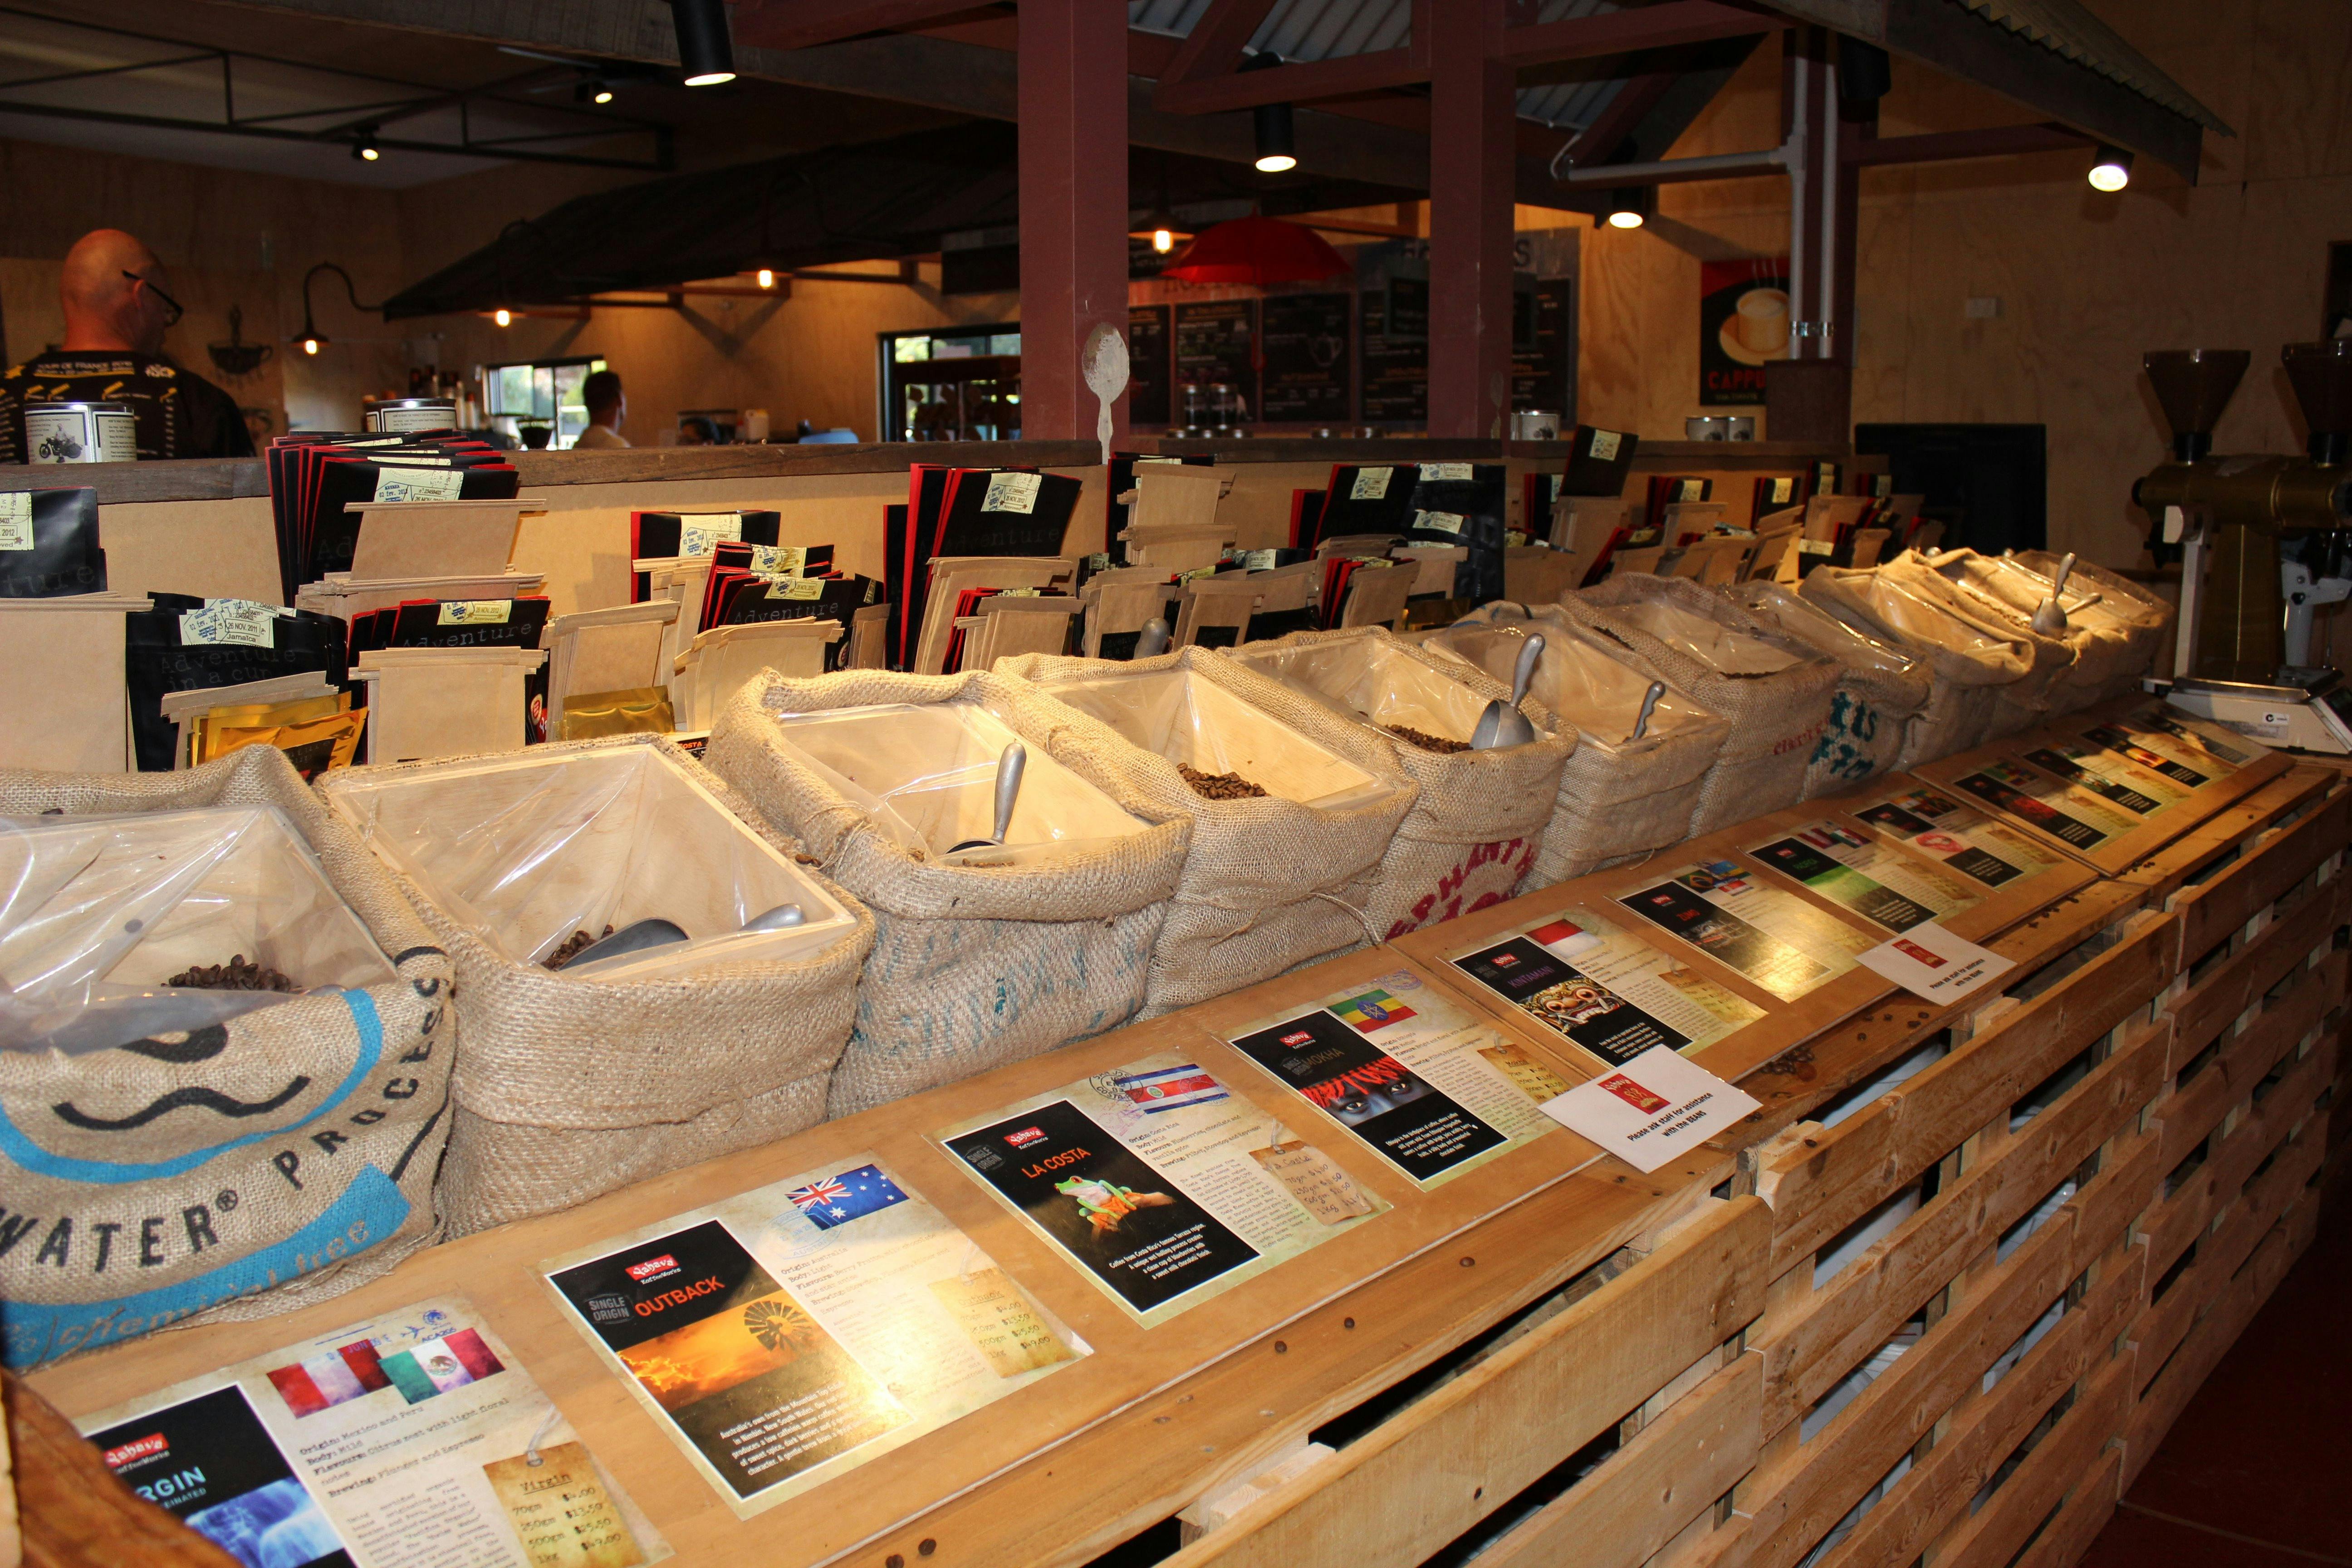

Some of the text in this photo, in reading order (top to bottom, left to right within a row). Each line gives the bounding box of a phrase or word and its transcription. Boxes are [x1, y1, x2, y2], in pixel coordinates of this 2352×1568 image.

[1708, 368, 1766, 390] CAPPU
[733, 603, 838, 625] Adventure
[403, 623, 531, 648] Adventure
[161, 647, 296, 675] Adventure
[209, 672, 223, 683] a
[1507, 965, 1555, 989] KINTAMANI
[1301, 1048, 1345, 1066] MOKHA
[1627, 1092, 1714, 1142] Please ask staff for assistance
[1661, 1110, 1707, 1137] with the BEANS
[1010, 1129, 1041, 1143] Yahava
[1128, 1133, 1151, 1143] Origin:
[1150, 1127, 1166, 1135] Costa
[1136, 1141, 1152, 1149] Body:
[1144, 1142, 1172, 1156] Flavours:
[1172, 1129, 1206, 1146] Blueberries,
[1205, 1119, 1230, 1132] chocolate
[966, 1147, 992, 1163] SINGLE
[1152, 1144, 1190, 1161] vanilla spice
[1159, 1126, 1261, 1169] Brewing: Filter, Stovetop Espresso
[976, 1154, 1002, 1170] ORIGIN
[1022, 1147, 1091, 1179] LA COSTA
[1285, 1175, 1307, 1184] 70gm
[295, 1219, 370, 1270] free
[1109, 1259, 1126, 1269] Coffee
[1134, 1249, 1149, 1257] Costa
[1147, 1242, 1161, 1252] Rica's
[1159, 1235, 1177, 1246] famous
[1190, 1223, 1206, 1233] region.
[1133, 1234, 1203, 1268] unique process creates
[633, 1258, 674, 1276] Yahava
[781, 1247, 848, 1275] Origin: Australia
[1147, 1263, 1160, 1272] clean
[1171, 1246, 1196, 1260] blueberries
[1155, 1250, 1212, 1278] sweet milk chocolate finish.
[640, 1267, 681, 1284] KoffeeWorks
[788, 1263, 833, 1283] Body: Light
[795, 1264, 856, 1291] Flavours: Berry
[589, 1297, 626, 1311] SINGLE
[635, 1276, 725, 1317] OUTBACK
[811, 1289, 847, 1306] Brewing:
[958, 1290, 1001, 1306] Outback
[996, 1302, 1021, 1313] $4.00
[593, 1307, 630, 1322] ORIGIN
[1002, 1313, 1030, 1326] $13.50
[978, 1324, 1040, 1348] 500gm $25.50
[989, 1336, 1050, 1359] 1kg $49.00
[720, 1394, 818, 1439] Australia's own from the Mountain
[733, 1407, 815, 1446] in Nimbin, New South Wales.
[300, 1406, 423, 1456] Origin: Mexico and Peru
[314, 1397, 510, 1476] Flavours: Citrus with light floral
[731, 1408, 836, 1460] produces low caffeine warm coffee
[307, 1441, 363, 1466] Body: Mild
[740, 1426, 820, 1467] of sweet spice, dark berries
[748, 1434, 833, 1476] character. gentle brew from
[322, 1470, 351, 1486] notes
[328, 1434, 485, 1498] Brewing: Plunger and Espresso
[135, 1466, 206, 1501] RGIN
[520, 1474, 571, 1491] Virgin
[513, 1504, 541, 1516] 70gm
[521, 1503, 603, 1532] 250gm $13.50
[528, 1518, 611, 1549] 500gm $25.50
[537, 1553, 559, 1564] 1kg
